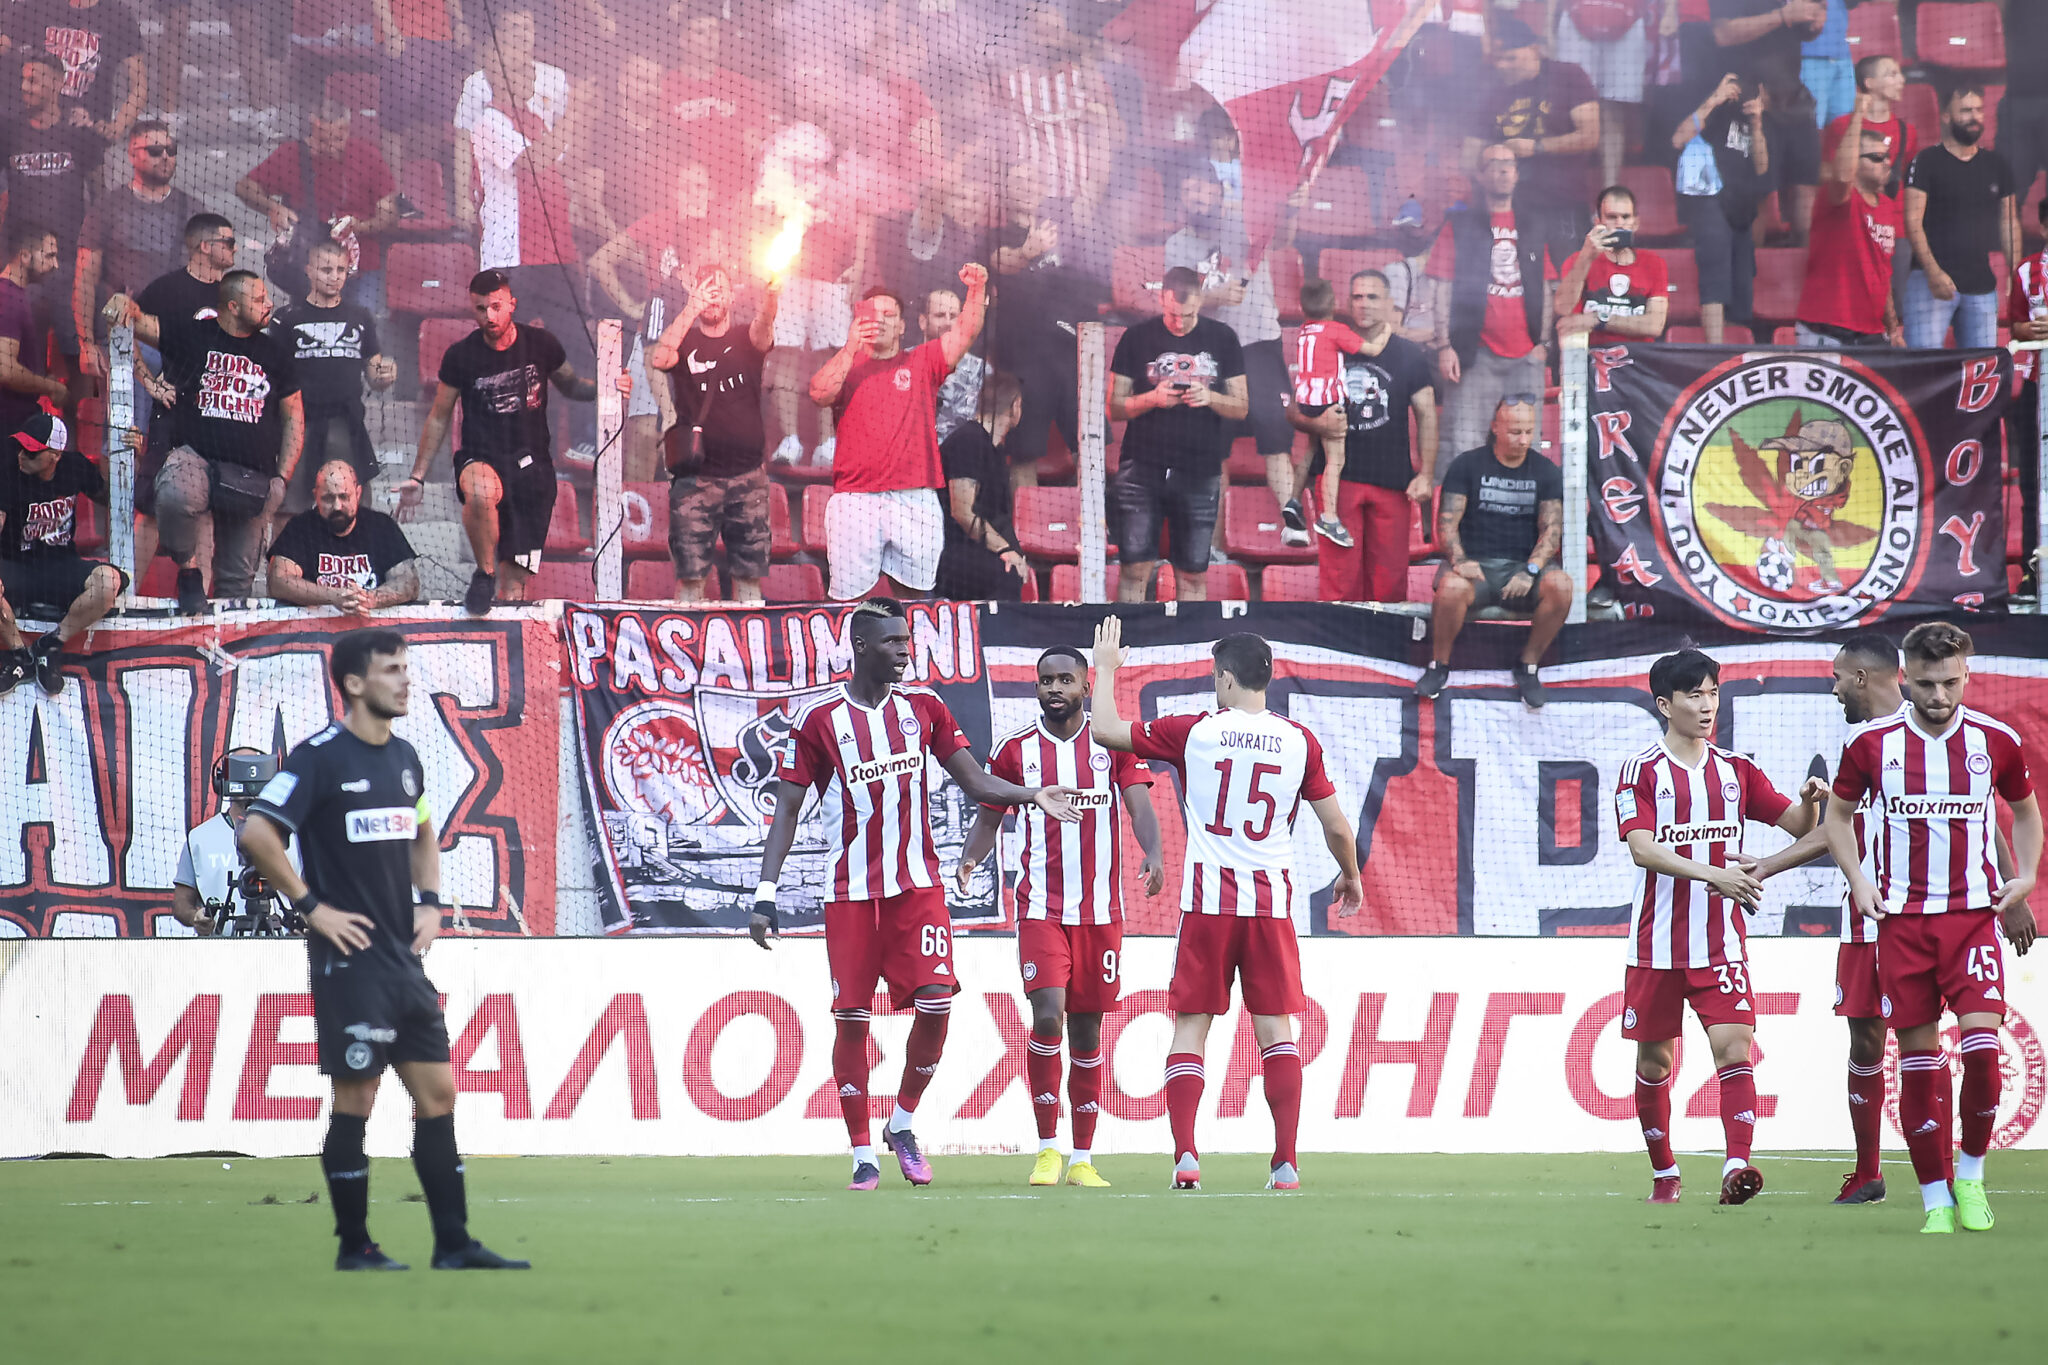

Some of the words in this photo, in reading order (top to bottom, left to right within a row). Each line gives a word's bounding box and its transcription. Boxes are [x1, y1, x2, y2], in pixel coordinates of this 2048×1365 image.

[205, 350, 266, 377] BORN
[198, 389, 265, 417] FIGHT
[1680, 365, 1790, 446] NEVER
[1804, 366, 1909, 467] SMOKE
[1863, 476, 1917, 596] ALONE
[318, 553, 371, 575] BORN
[567, 600, 981, 694] PASALIMNI
[1220, 730, 1282, 754] SOKRATIS
[249, 765, 257, 778] 3
[1204, 758, 1283, 842] 15
[1888, 795, 1984, 816] Stoiximan
[1657, 824, 1738, 844] Stoiximan
[208, 853, 233, 868] TV
[920, 923, 949, 958] 66
[1966, 944, 2000, 982] 45
[1712, 962, 1748, 995] 33
